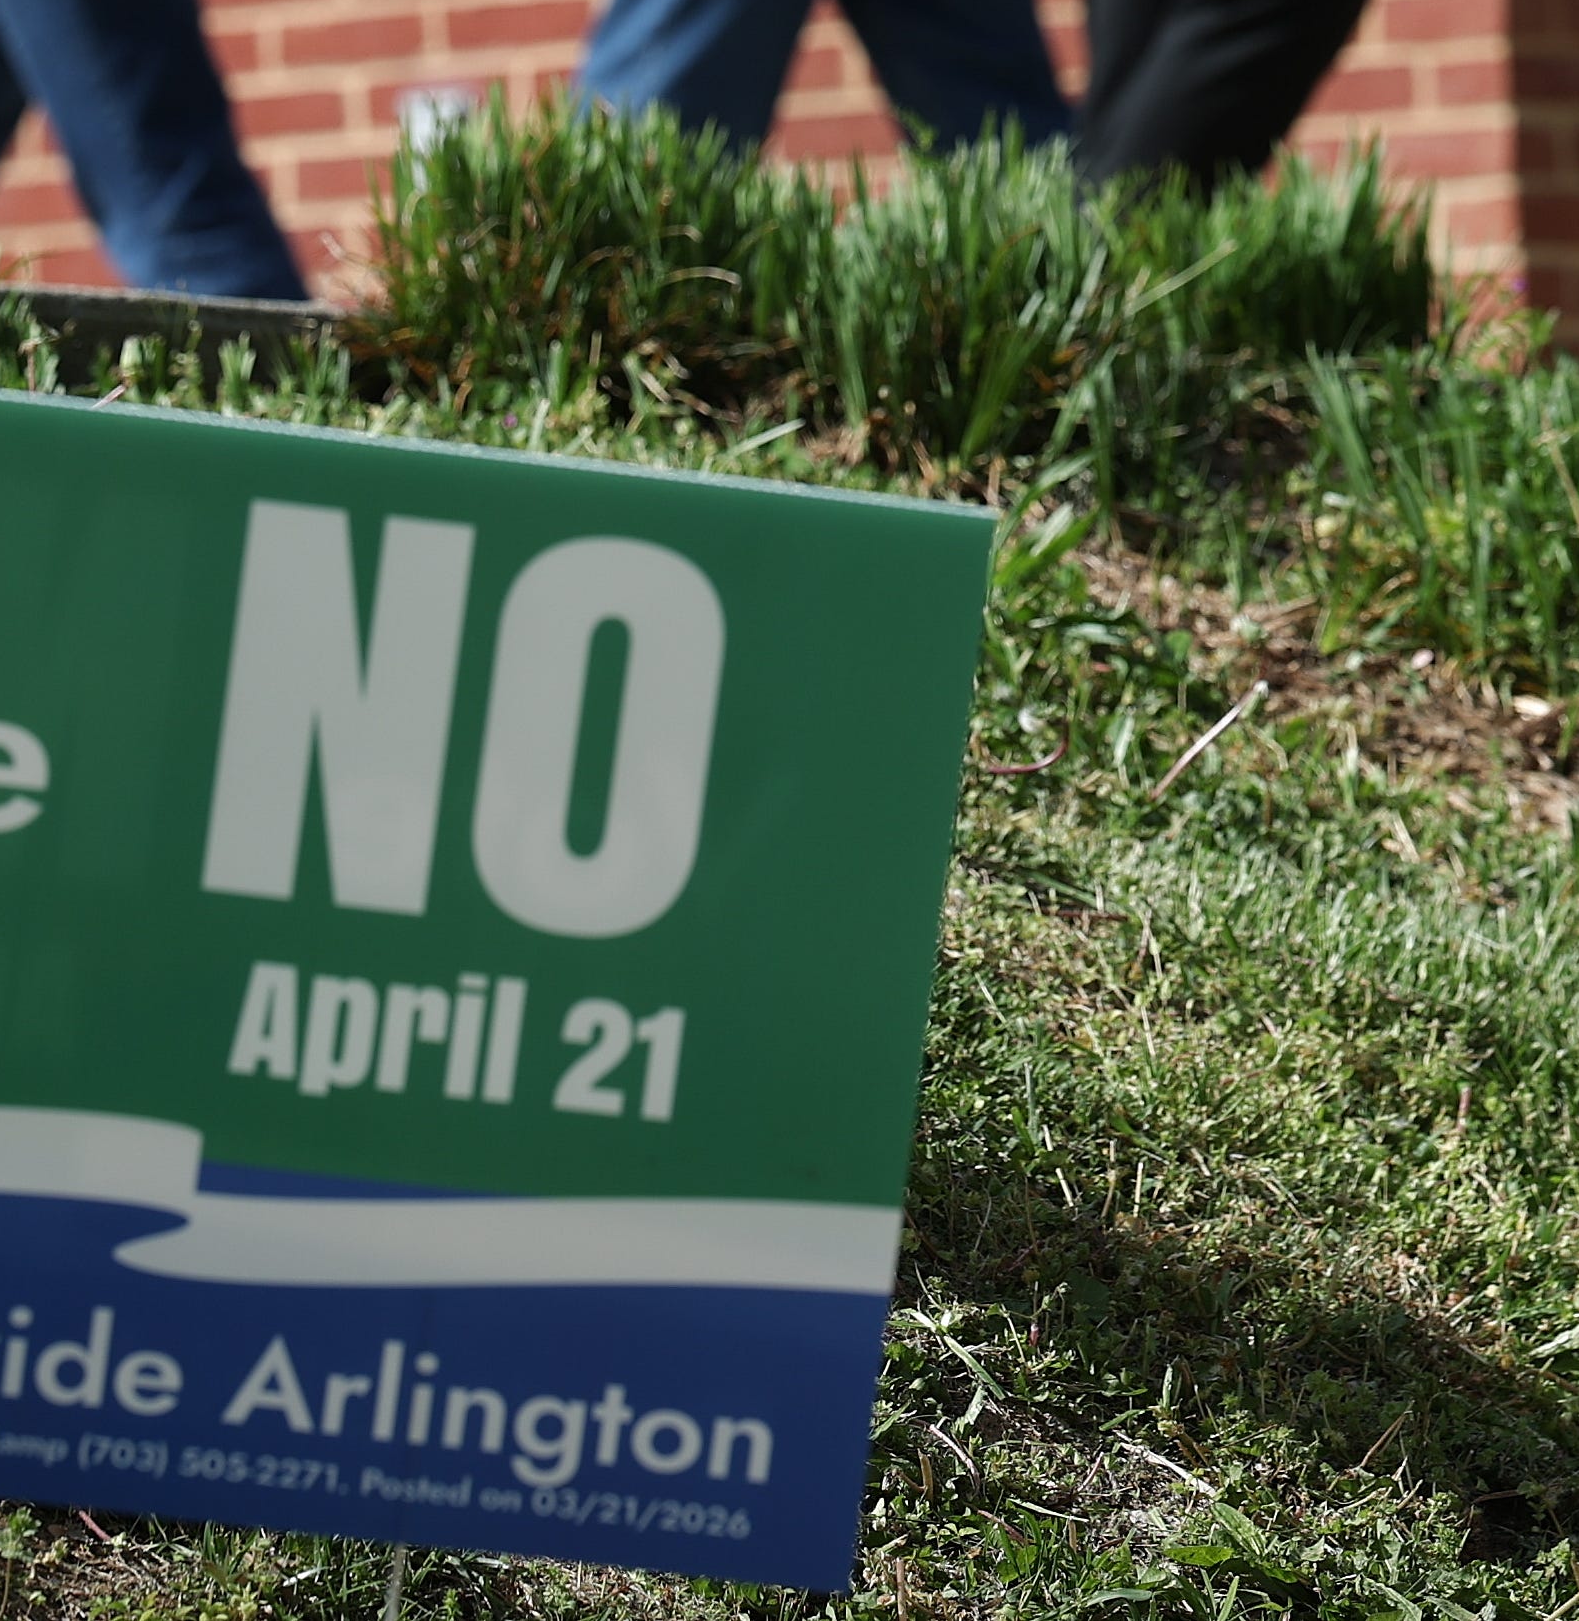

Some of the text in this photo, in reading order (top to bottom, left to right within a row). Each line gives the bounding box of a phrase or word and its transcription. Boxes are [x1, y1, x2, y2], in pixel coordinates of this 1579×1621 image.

[201, 499, 726, 940] NO
[227, 961, 529, 1105] April
[553, 997, 686, 1122] 21
[78, 1432, 169, 1479] (703)
[179, 1445, 349, 1496] 505-2271.
[362, 1467, 472, 1508] Posted
[481, 1485, 522, 1513] on
[532, 1486, 752, 1541] 03/21/2026
[222, 1336, 774, 1485] Arlington
